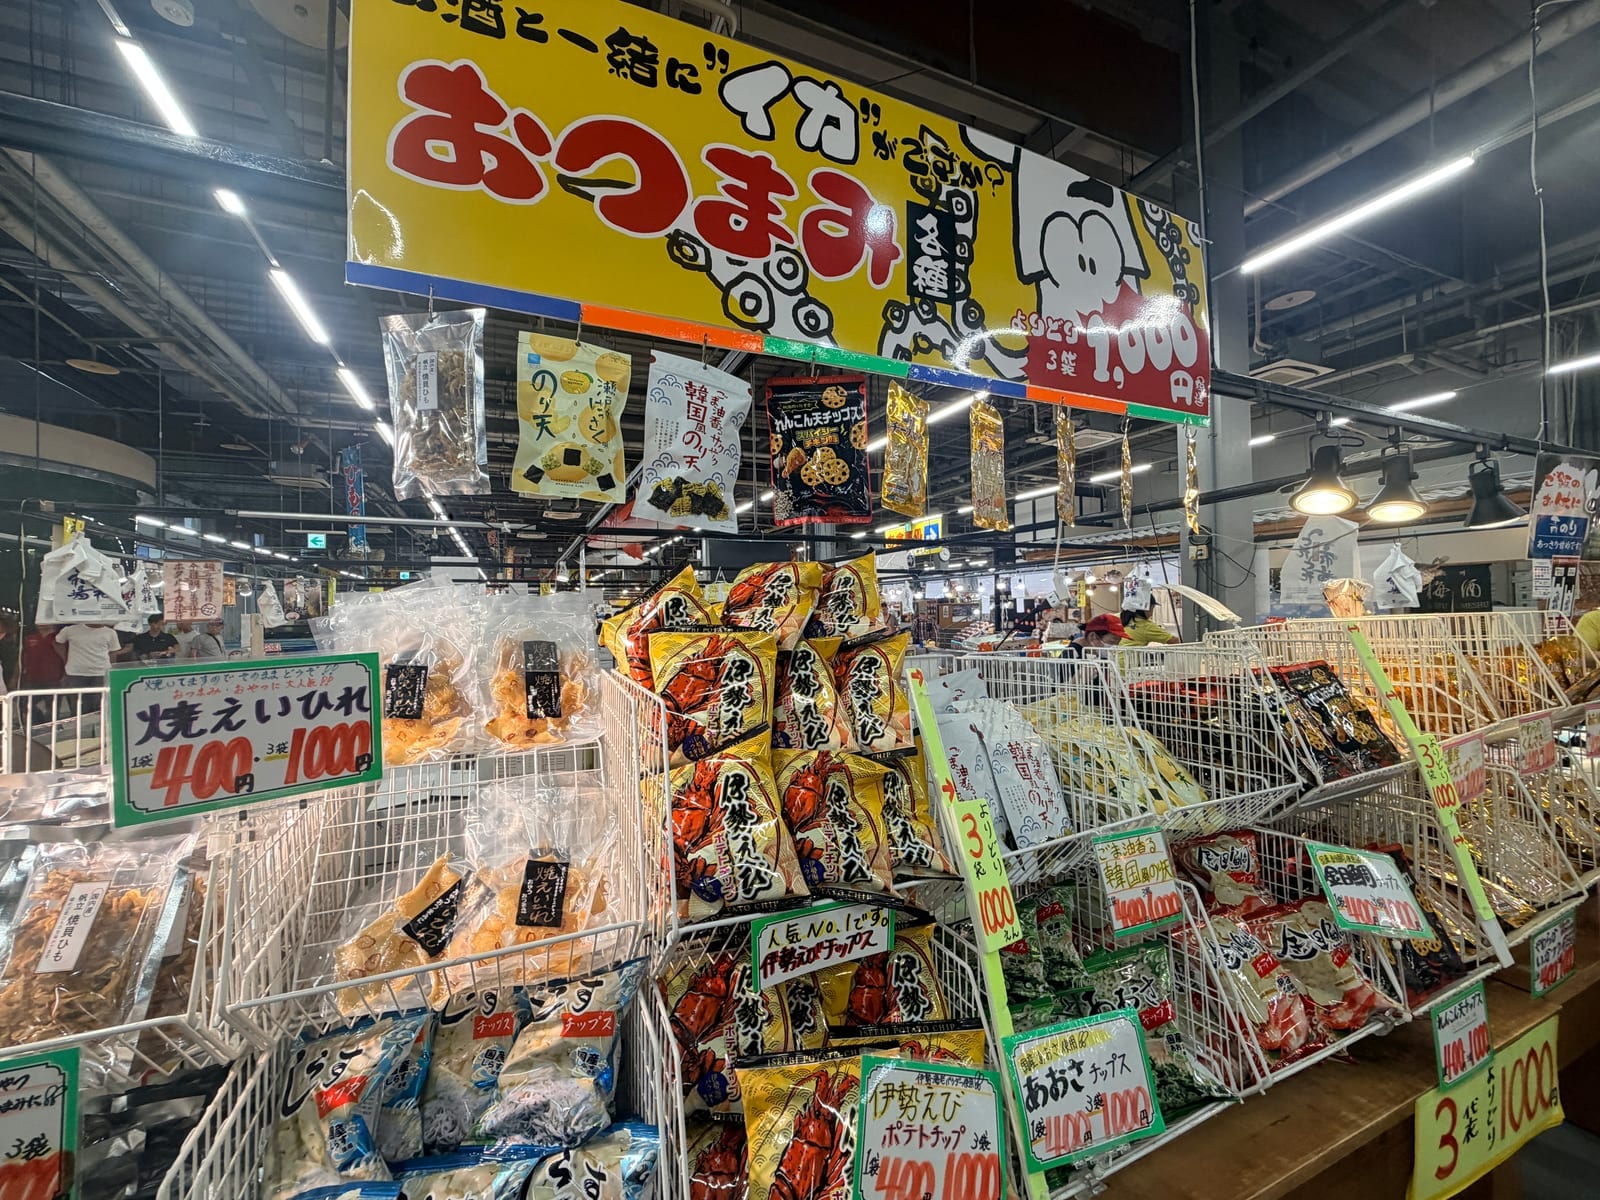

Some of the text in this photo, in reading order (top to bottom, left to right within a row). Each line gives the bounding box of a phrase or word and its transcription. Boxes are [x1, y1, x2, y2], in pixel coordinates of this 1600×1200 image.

[391, 0, 702, 94] 酒と一緒に
[386, 58, 904, 290] おつまみ
[912, 212, 950, 298] 各種
[1045, 349, 1078, 377] 3袋
[531, 369, 558, 441] のり天
[682, 380, 710, 472] 韓国風のり天
[135, 685, 371, 746] 焼えいひれ
[721, 658, 752, 739] 伊勢え
[790, 648, 829, 747] 伊勢えび
[850, 655, 884, 745] 伊勢えび
[719, 770, 772, 899] 伊勢えび
[826, 780, 873, 882] 伊勢えび
[978, 802, 1003, 877] よりどり
[1098, 835, 1157, 861] ごま油香る
[760, 930, 879, 980] 伊勢えびチップス
[892, 953, 929, 1021] 伊勢
[476, 1017, 512, 1033] チップス
[565, 1015, 612, 1033] チップス
[281, 1048, 364, 1118] しらす
[868, 1081, 966, 1123] 伊勢えび
[1023, 1052, 1132, 1113] あおさ チップス
[1486, 1066, 1498, 1151] よりどり
[880, 1119, 967, 1151] ポテトチップ
